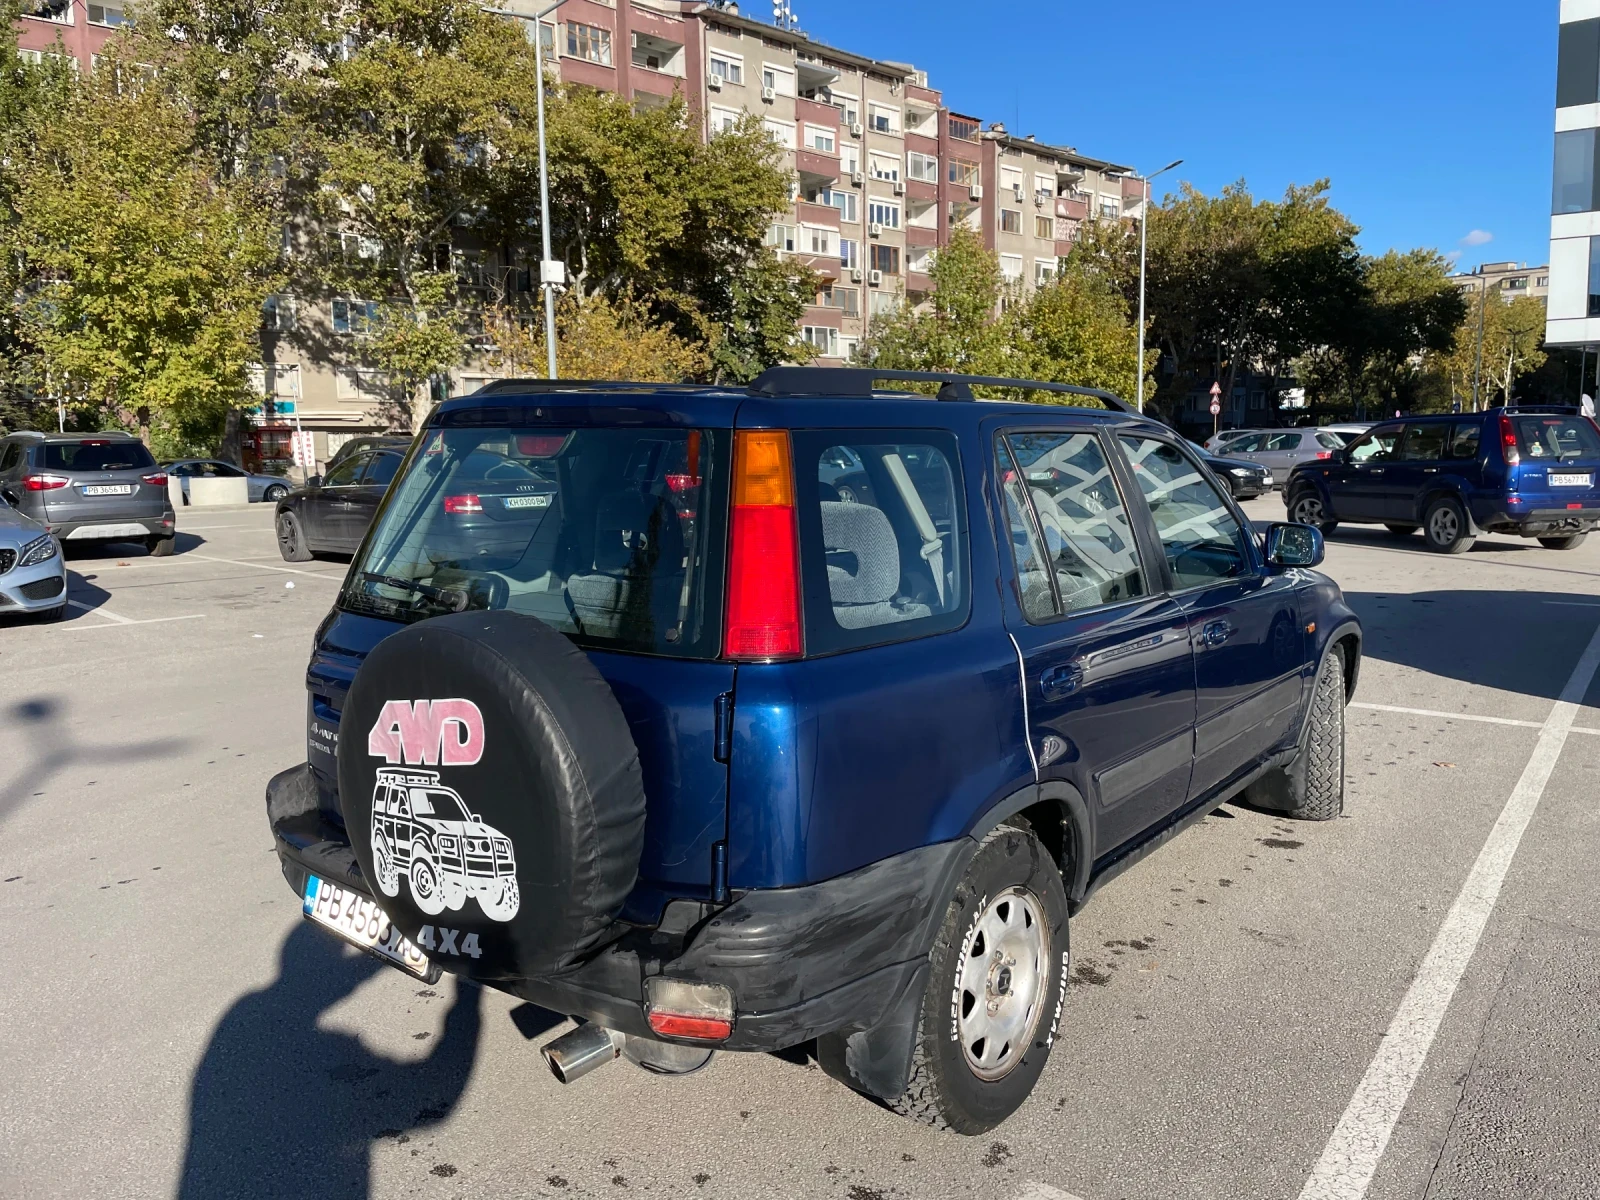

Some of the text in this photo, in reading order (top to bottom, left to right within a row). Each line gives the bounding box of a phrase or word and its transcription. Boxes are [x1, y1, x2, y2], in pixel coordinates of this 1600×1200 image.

[88, 485, 129, 494] PB 3656 TE
[520, 497, 536, 506] 0300
[368, 698, 486, 766] 4WD
[316, 884, 343, 919] PB
[416, 924, 483, 959] 4X4
[1046, 951, 1069, 1049] GRIPMAX
